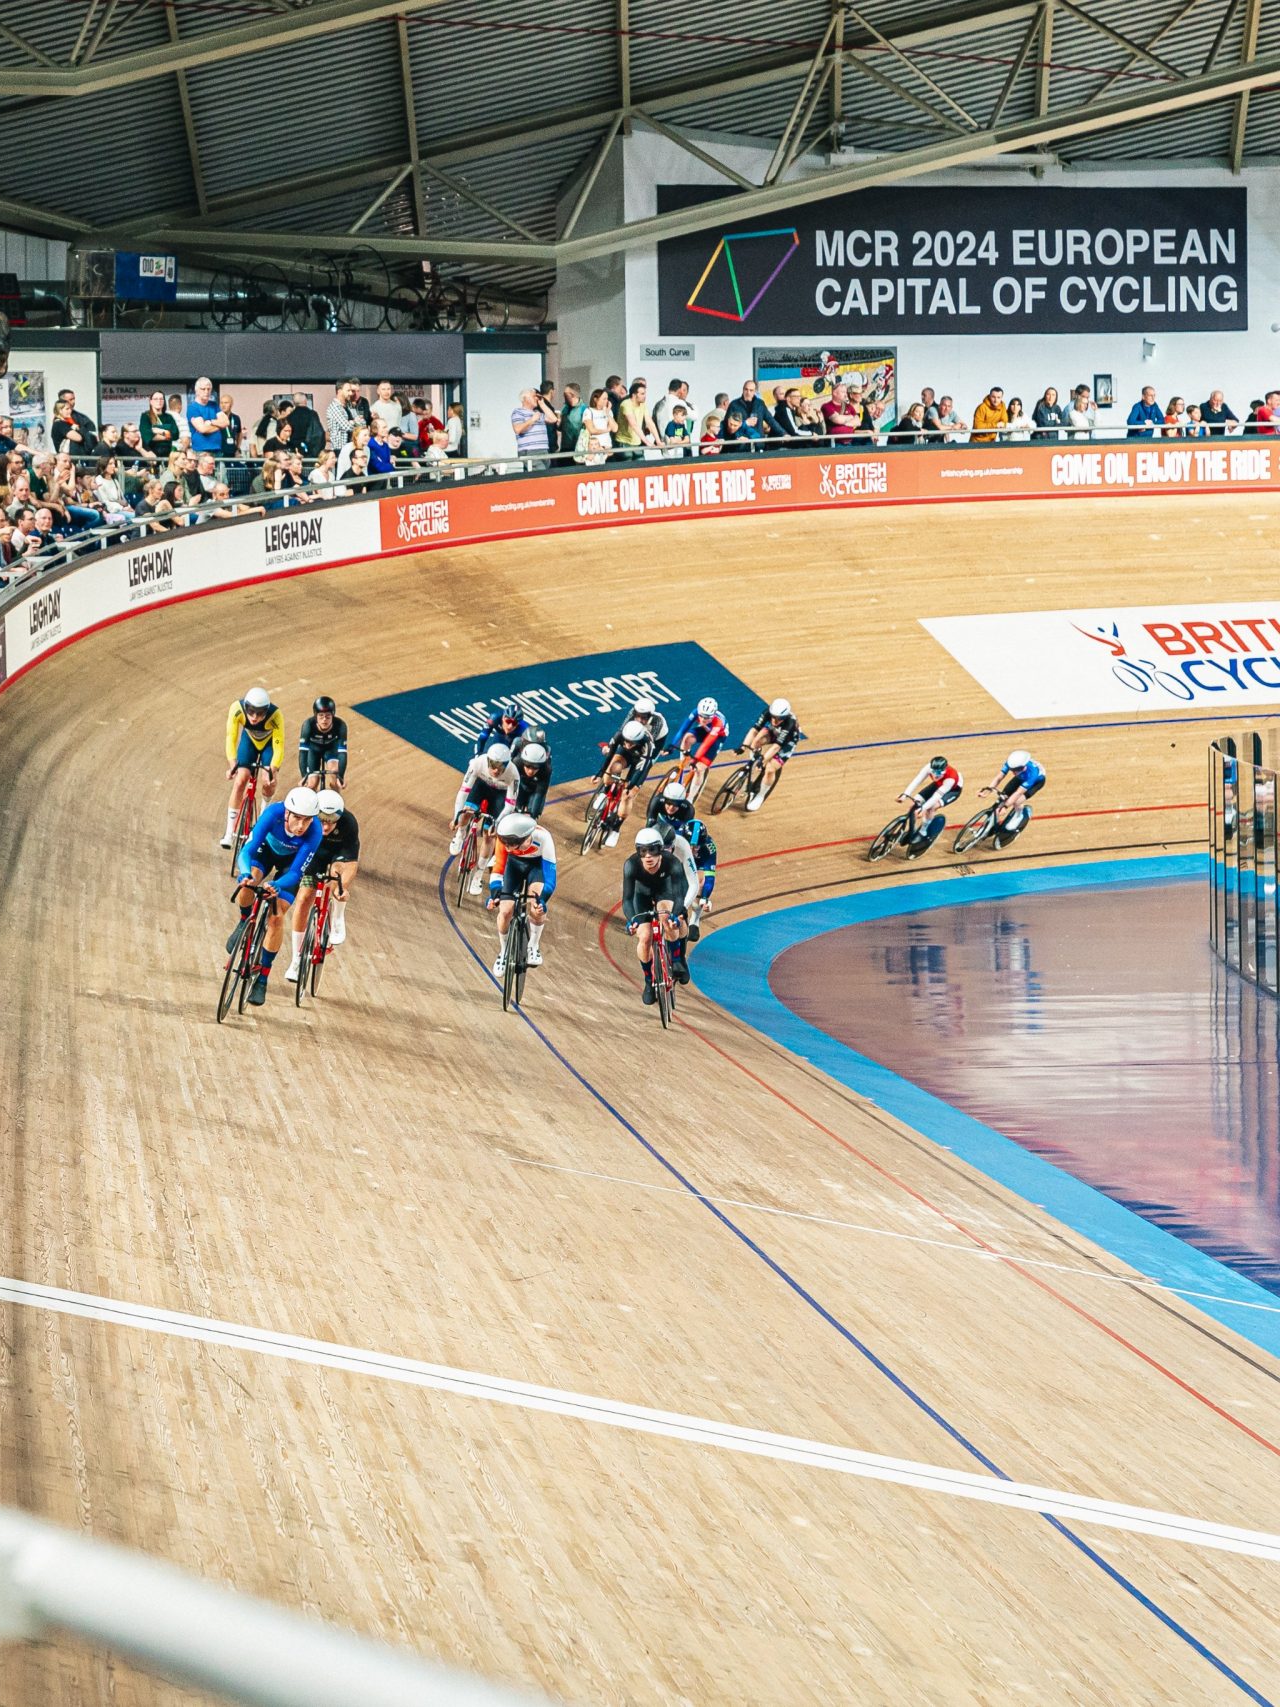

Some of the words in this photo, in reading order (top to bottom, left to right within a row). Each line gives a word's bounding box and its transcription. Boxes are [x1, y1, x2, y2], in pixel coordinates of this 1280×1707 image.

[815, 230, 899, 267] MCR
[912, 229, 999, 267] 2024
[1012, 228, 1237, 266] EUROPEAN
[815, 277, 981, 317] CAPITAL
[992, 276, 1048, 315] OF
[1059, 274, 1238, 314] CYCLING
[645, 348, 667, 357] South
[669, 348, 690, 357] Curve
[835, 462, 887, 480] BRITISH
[836, 477, 888, 495] CYCLING
[1051, 454, 1102, 486] COME
[1104, 452, 1134, 487] ON,
[1136, 451, 1192, 483] ENJOY
[1195, 450, 1227, 482] THE
[1230, 448, 1271, 480] RIDE
[409, 500, 449, 521] BRITISH
[577, 479, 618, 516] COME
[620, 478, 645, 514] ON,
[645, 474, 691, 509] ENJOY
[692, 471, 721, 505] THE
[721, 468, 756, 503] RIDE
[265, 521, 299, 553] LEIGH
[300, 517, 323, 546] DAY
[410, 517, 450, 538] CYCLING
[128, 552, 155, 587] LEIGH
[155, 547, 173, 579] DAY
[29, 595, 48, 636] LEIGH
[48, 587, 61, 623] DAY
[490, 686, 590, 727] WITH
[568, 671, 681, 714] SPORT
